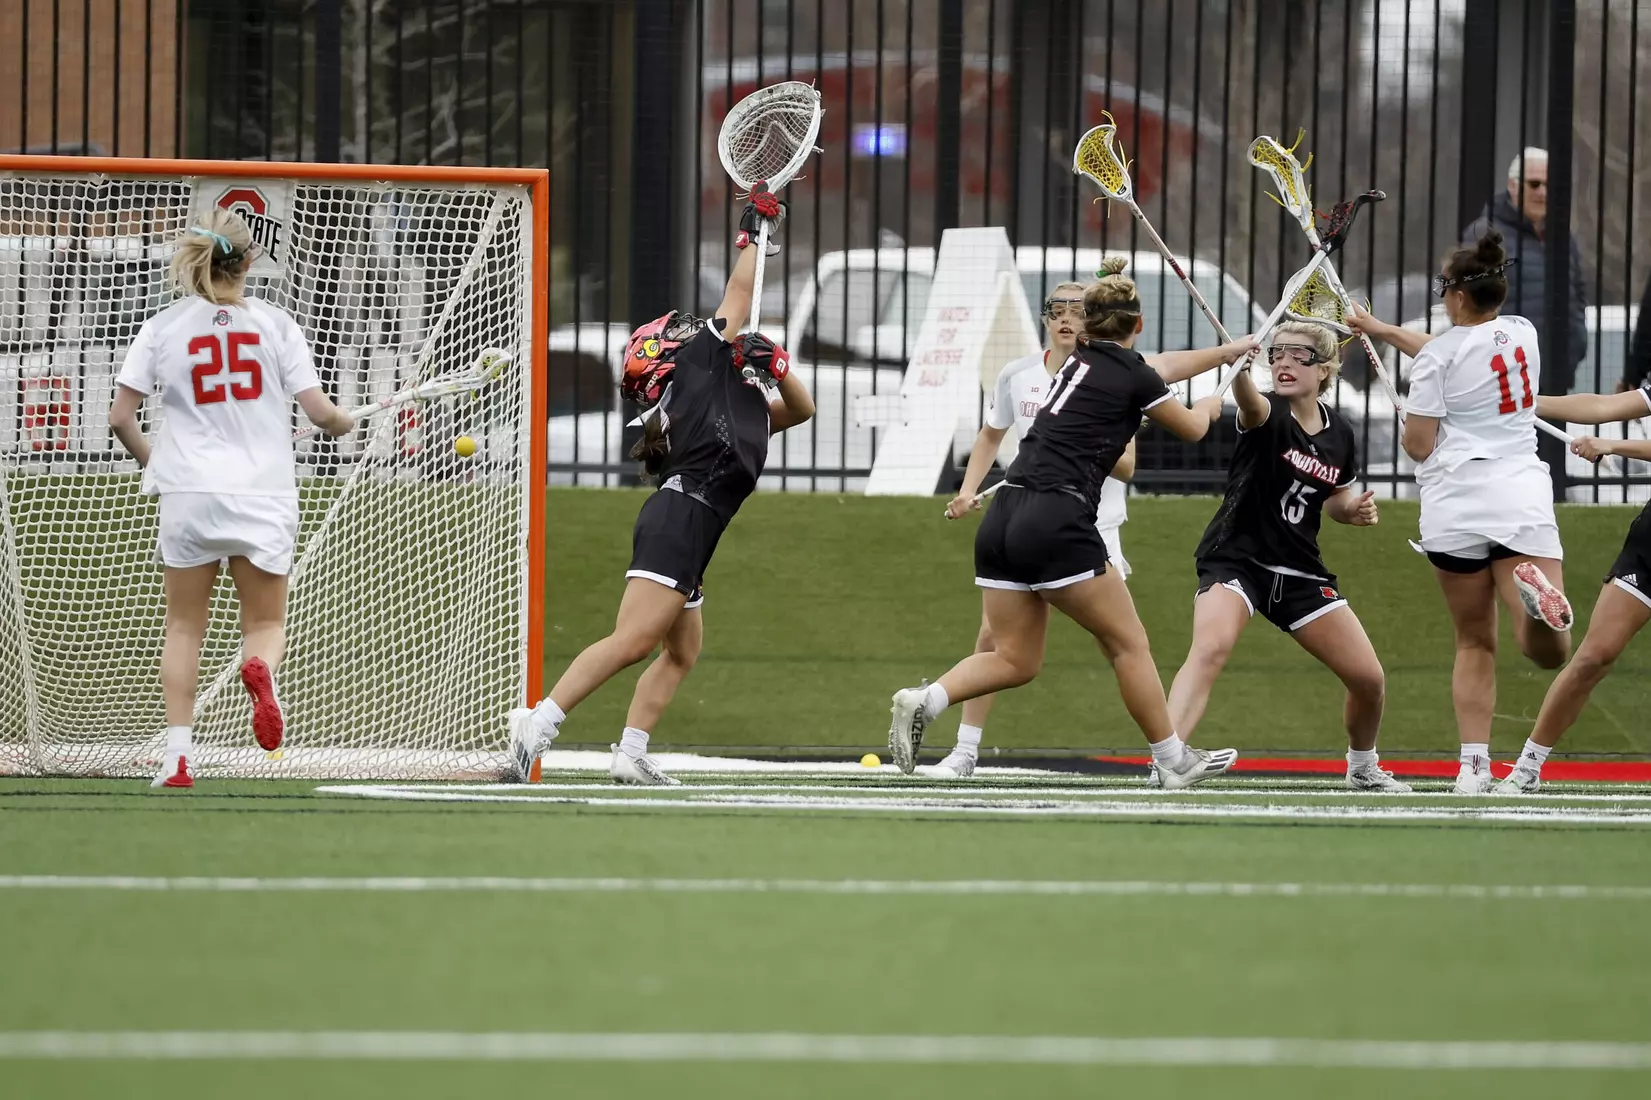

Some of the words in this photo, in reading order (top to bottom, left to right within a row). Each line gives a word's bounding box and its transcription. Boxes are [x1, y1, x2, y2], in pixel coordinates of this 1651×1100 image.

[188, 332, 262, 405] 25
[1490, 346, 1533, 414] 11
[1020, 400, 1042, 418] OHI
[1280, 478, 1318, 525] 15
